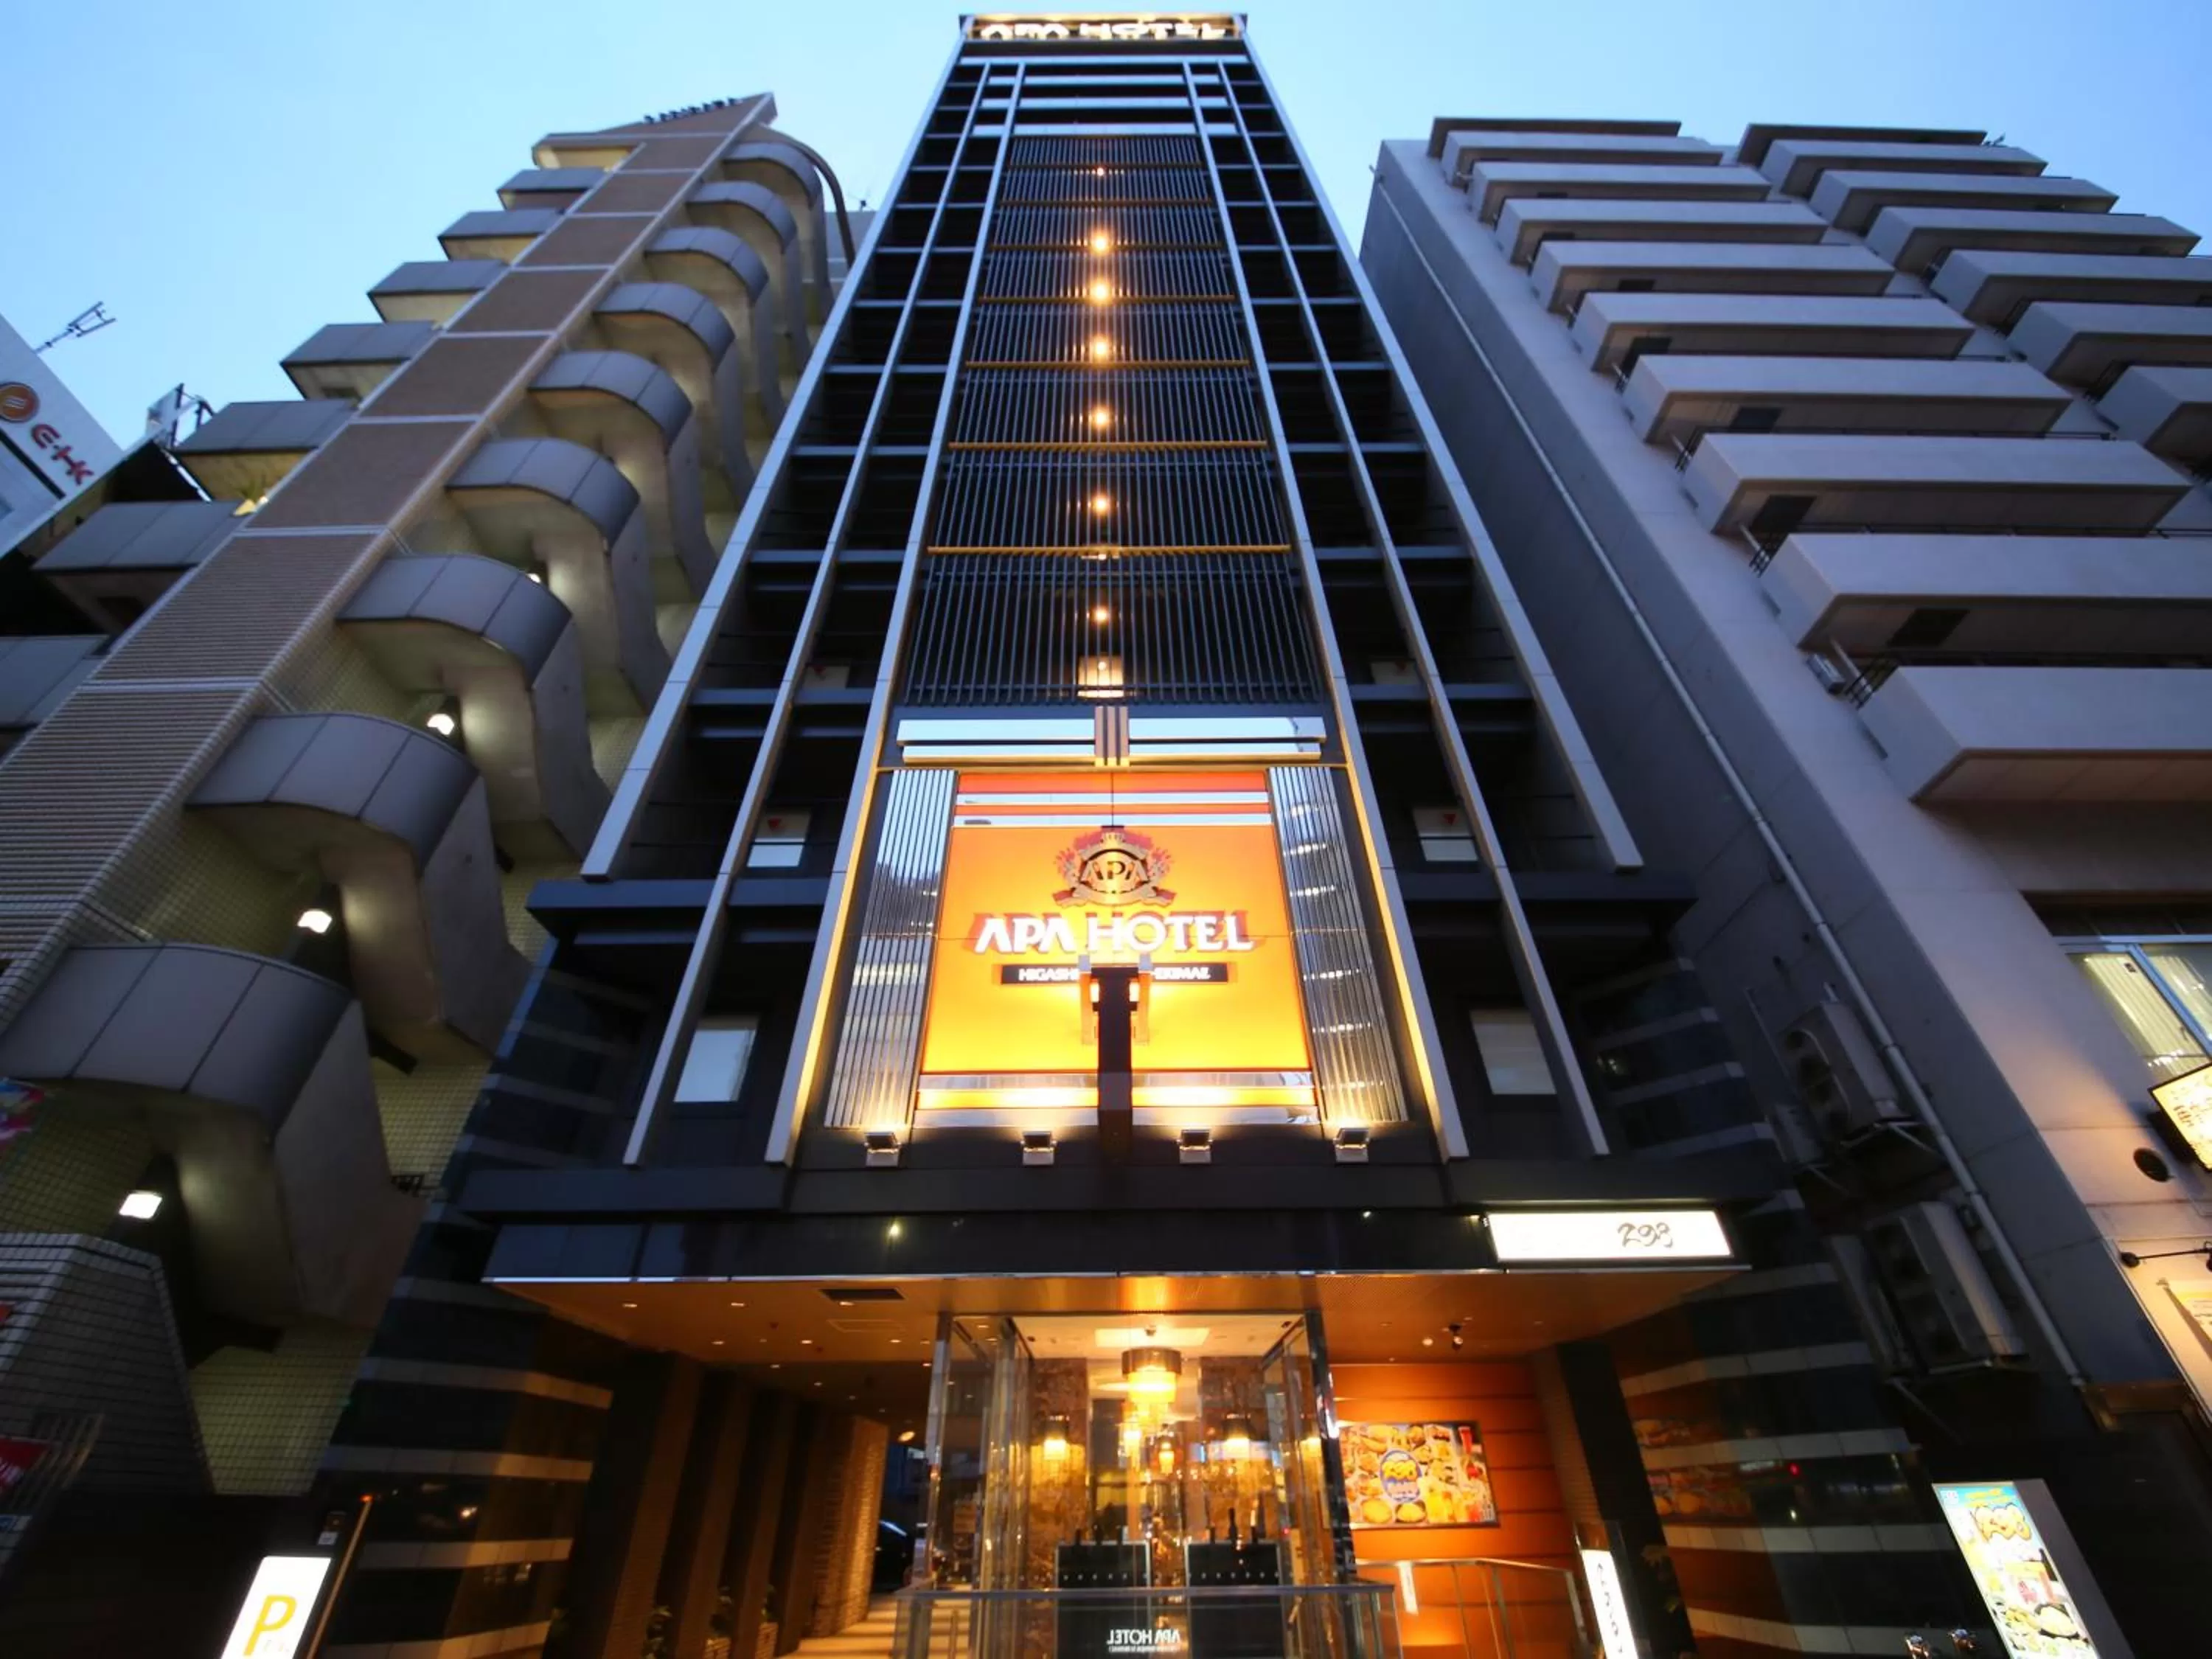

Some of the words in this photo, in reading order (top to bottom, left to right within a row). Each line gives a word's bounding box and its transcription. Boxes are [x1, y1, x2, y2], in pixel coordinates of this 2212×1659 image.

[973, 917, 1076, 953] APA
[1088, 914, 1254, 953] HOTEL
[242, 1595, 298, 1657] P
